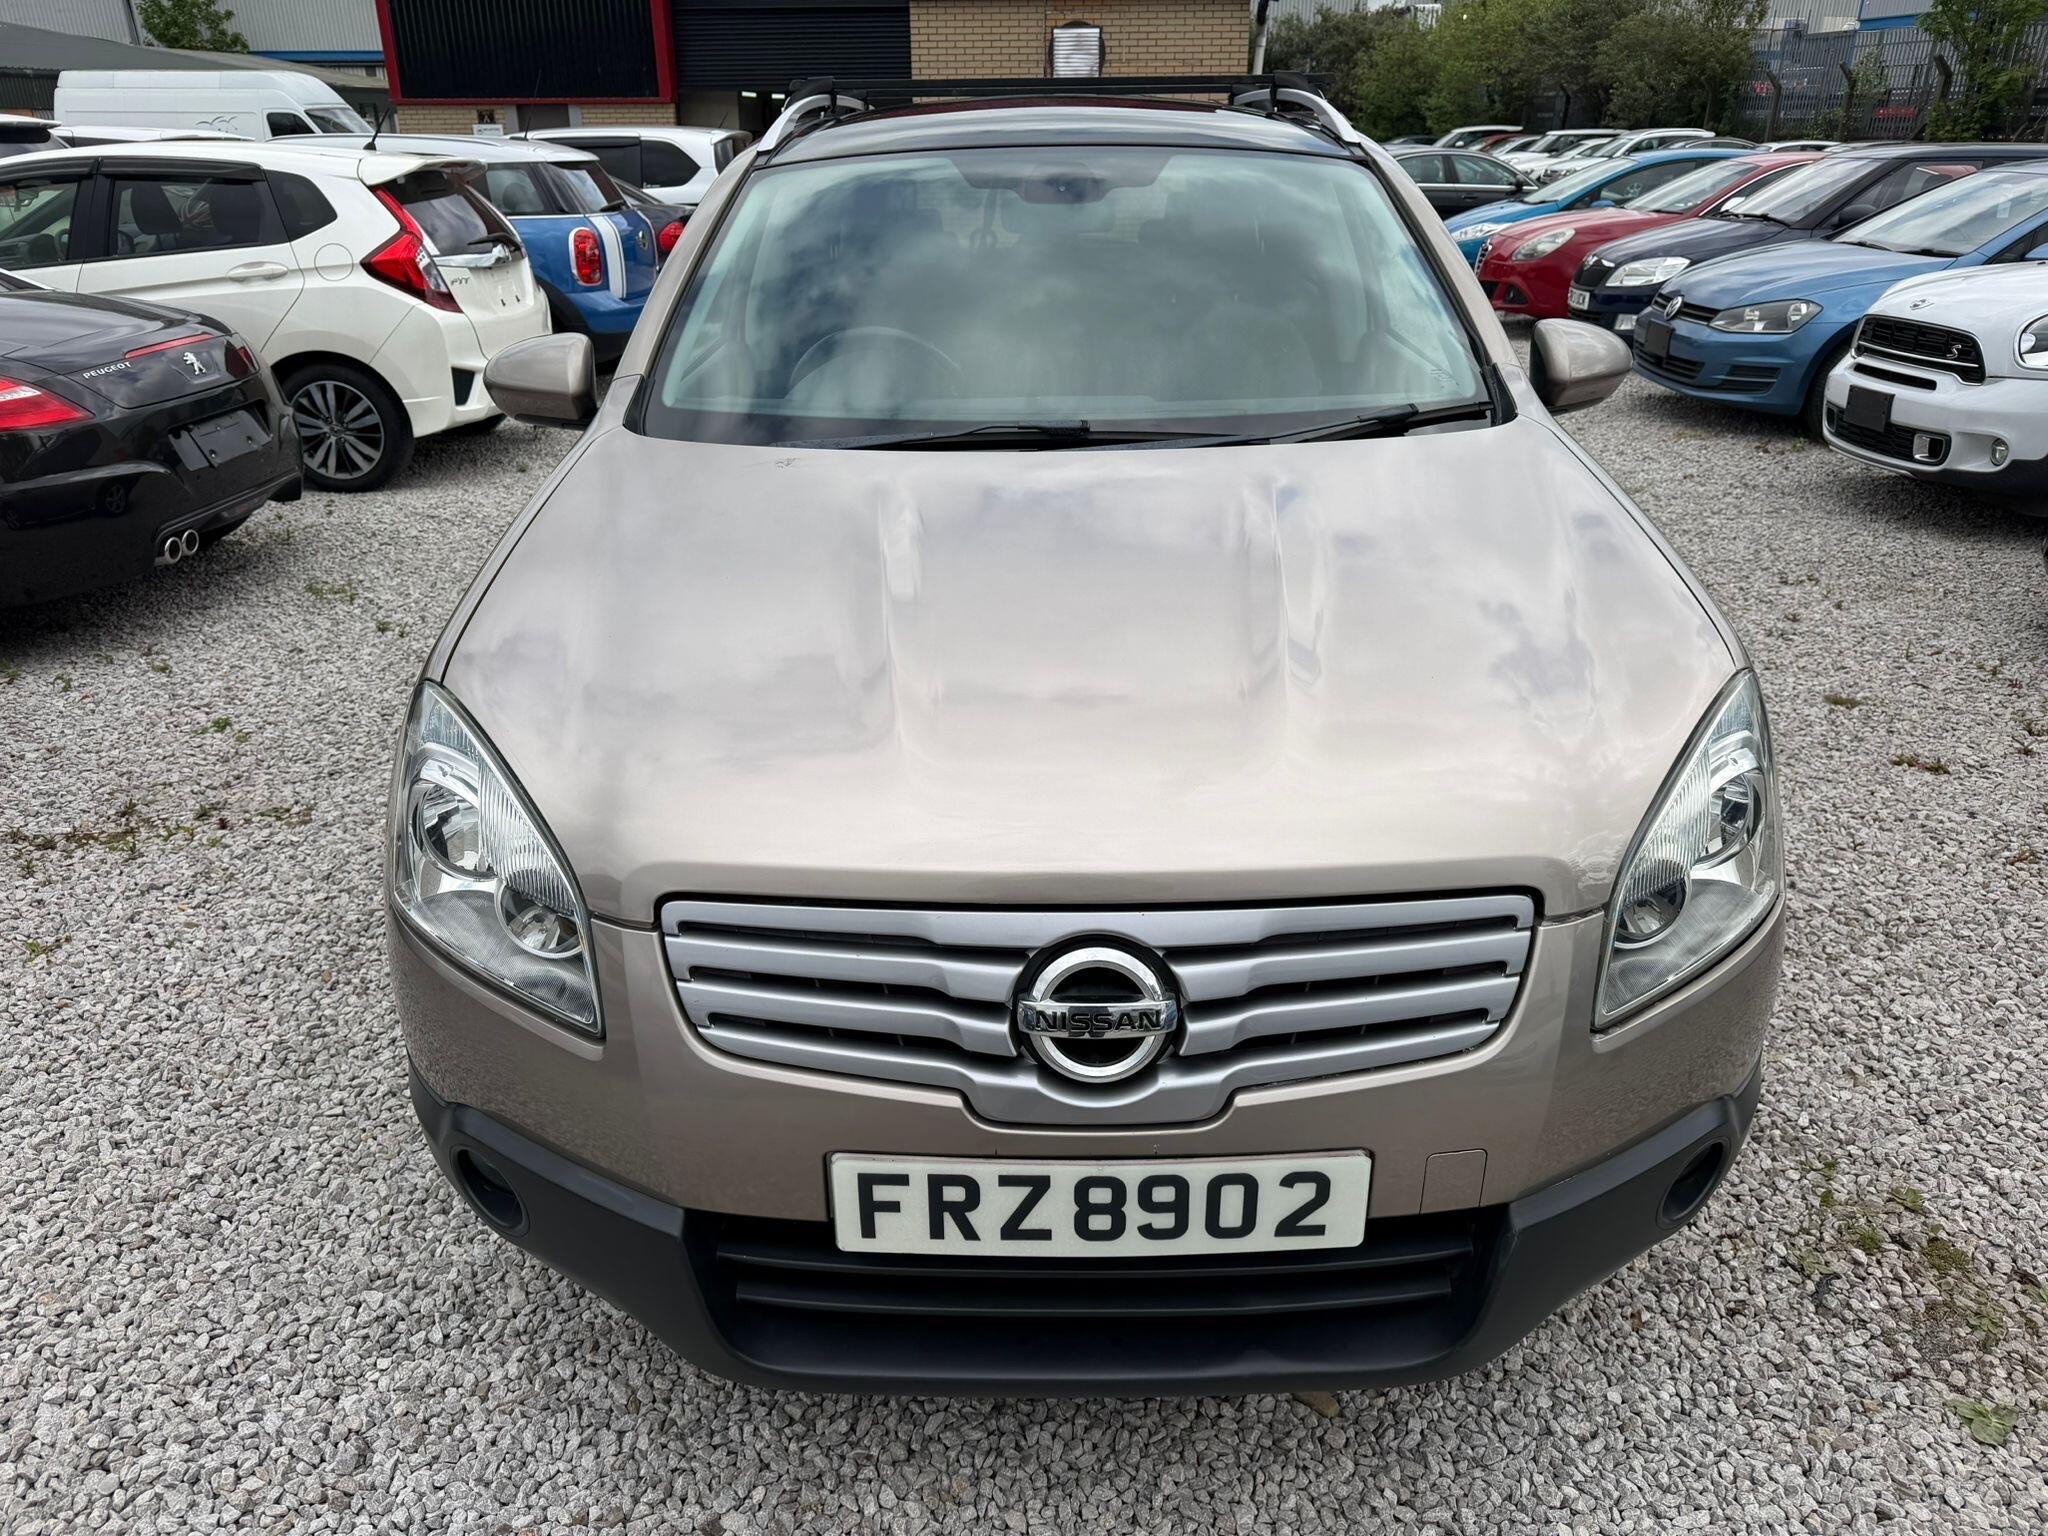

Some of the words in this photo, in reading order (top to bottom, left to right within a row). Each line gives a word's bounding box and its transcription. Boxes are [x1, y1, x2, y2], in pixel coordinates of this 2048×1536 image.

[82, 361, 132, 378] PEUGEOT
[1035, 1008, 1162, 1032] NISSAN
[857, 1171, 1332, 1242] FRZ8902
